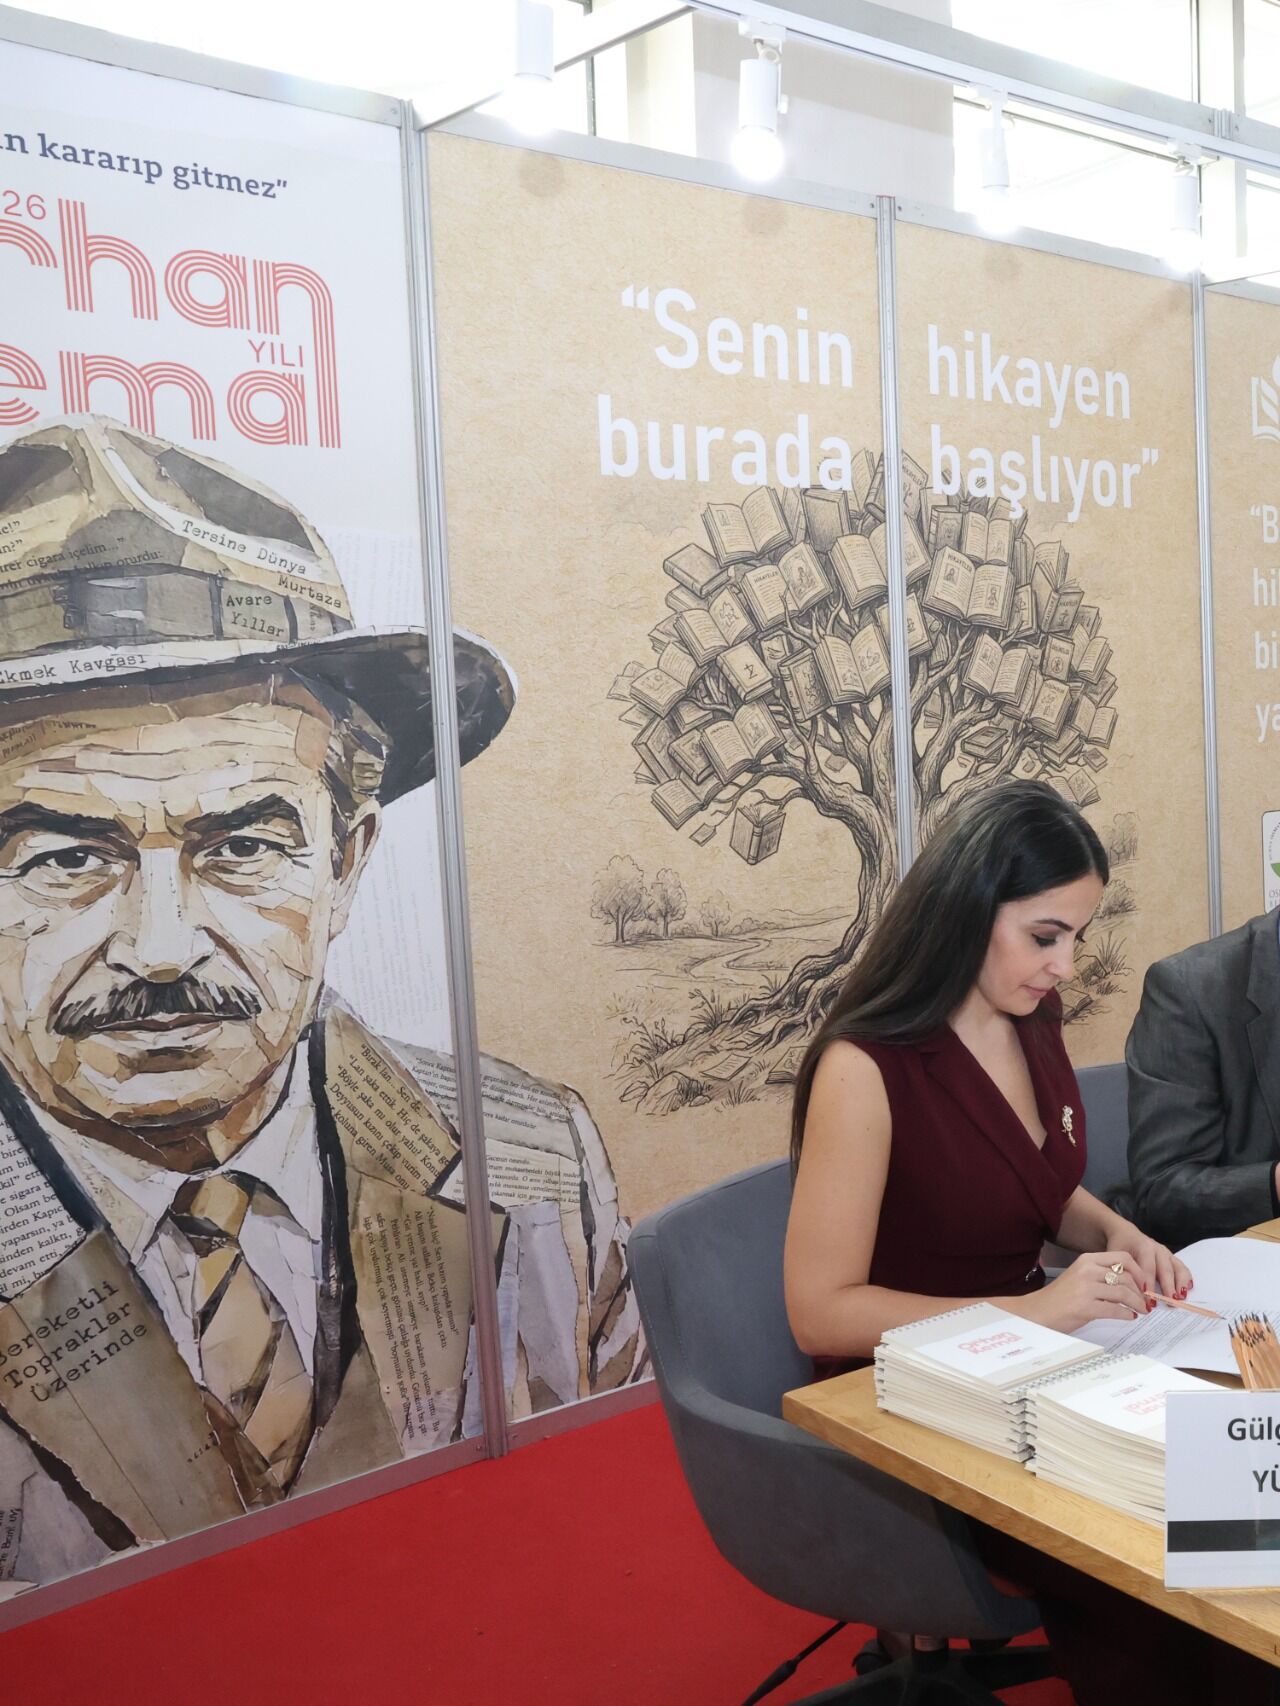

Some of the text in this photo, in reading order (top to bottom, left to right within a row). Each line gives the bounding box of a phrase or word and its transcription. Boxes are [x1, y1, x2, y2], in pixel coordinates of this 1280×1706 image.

[37, 132, 163, 184] kararıp
[248, 339, 304, 368] YILI
[621, 285, 1131, 429] “Senin hikayen
[597, 394, 1160, 523] burada başlıyor”
[182, 519, 306, 575] Tersine Dünya
[226, 595, 273, 607] Avare
[278, 574, 342, 609] Murtaza
[231, 611, 285, 637] Yıllar
[69, 653, 148, 675] Kavgası
[358, 1090, 374, 1109] şaka
[386, 1118, 401, 1135] olur
[364, 1073, 380, 1092] şaka
[411, 1122, 420, 1133] de
[419, 1132, 440, 1156] şakaya
[397, 1086, 411, 1101] Sen
[335, 1110, 358, 1136] koluna
[357, 1135, 375, 1156] giren
[396, 1174, 408, 1189] onu
[364, 1118, 383, 1139] kızını
[382, 1138, 401, 1160] çekip
[3, 1199, 40, 1217] Olsam
[8, 1184, 41, 1202] sigara
[3, 1303, 131, 1388] Topraklar
[30, 1324, 147, 1402] Üzerinde
